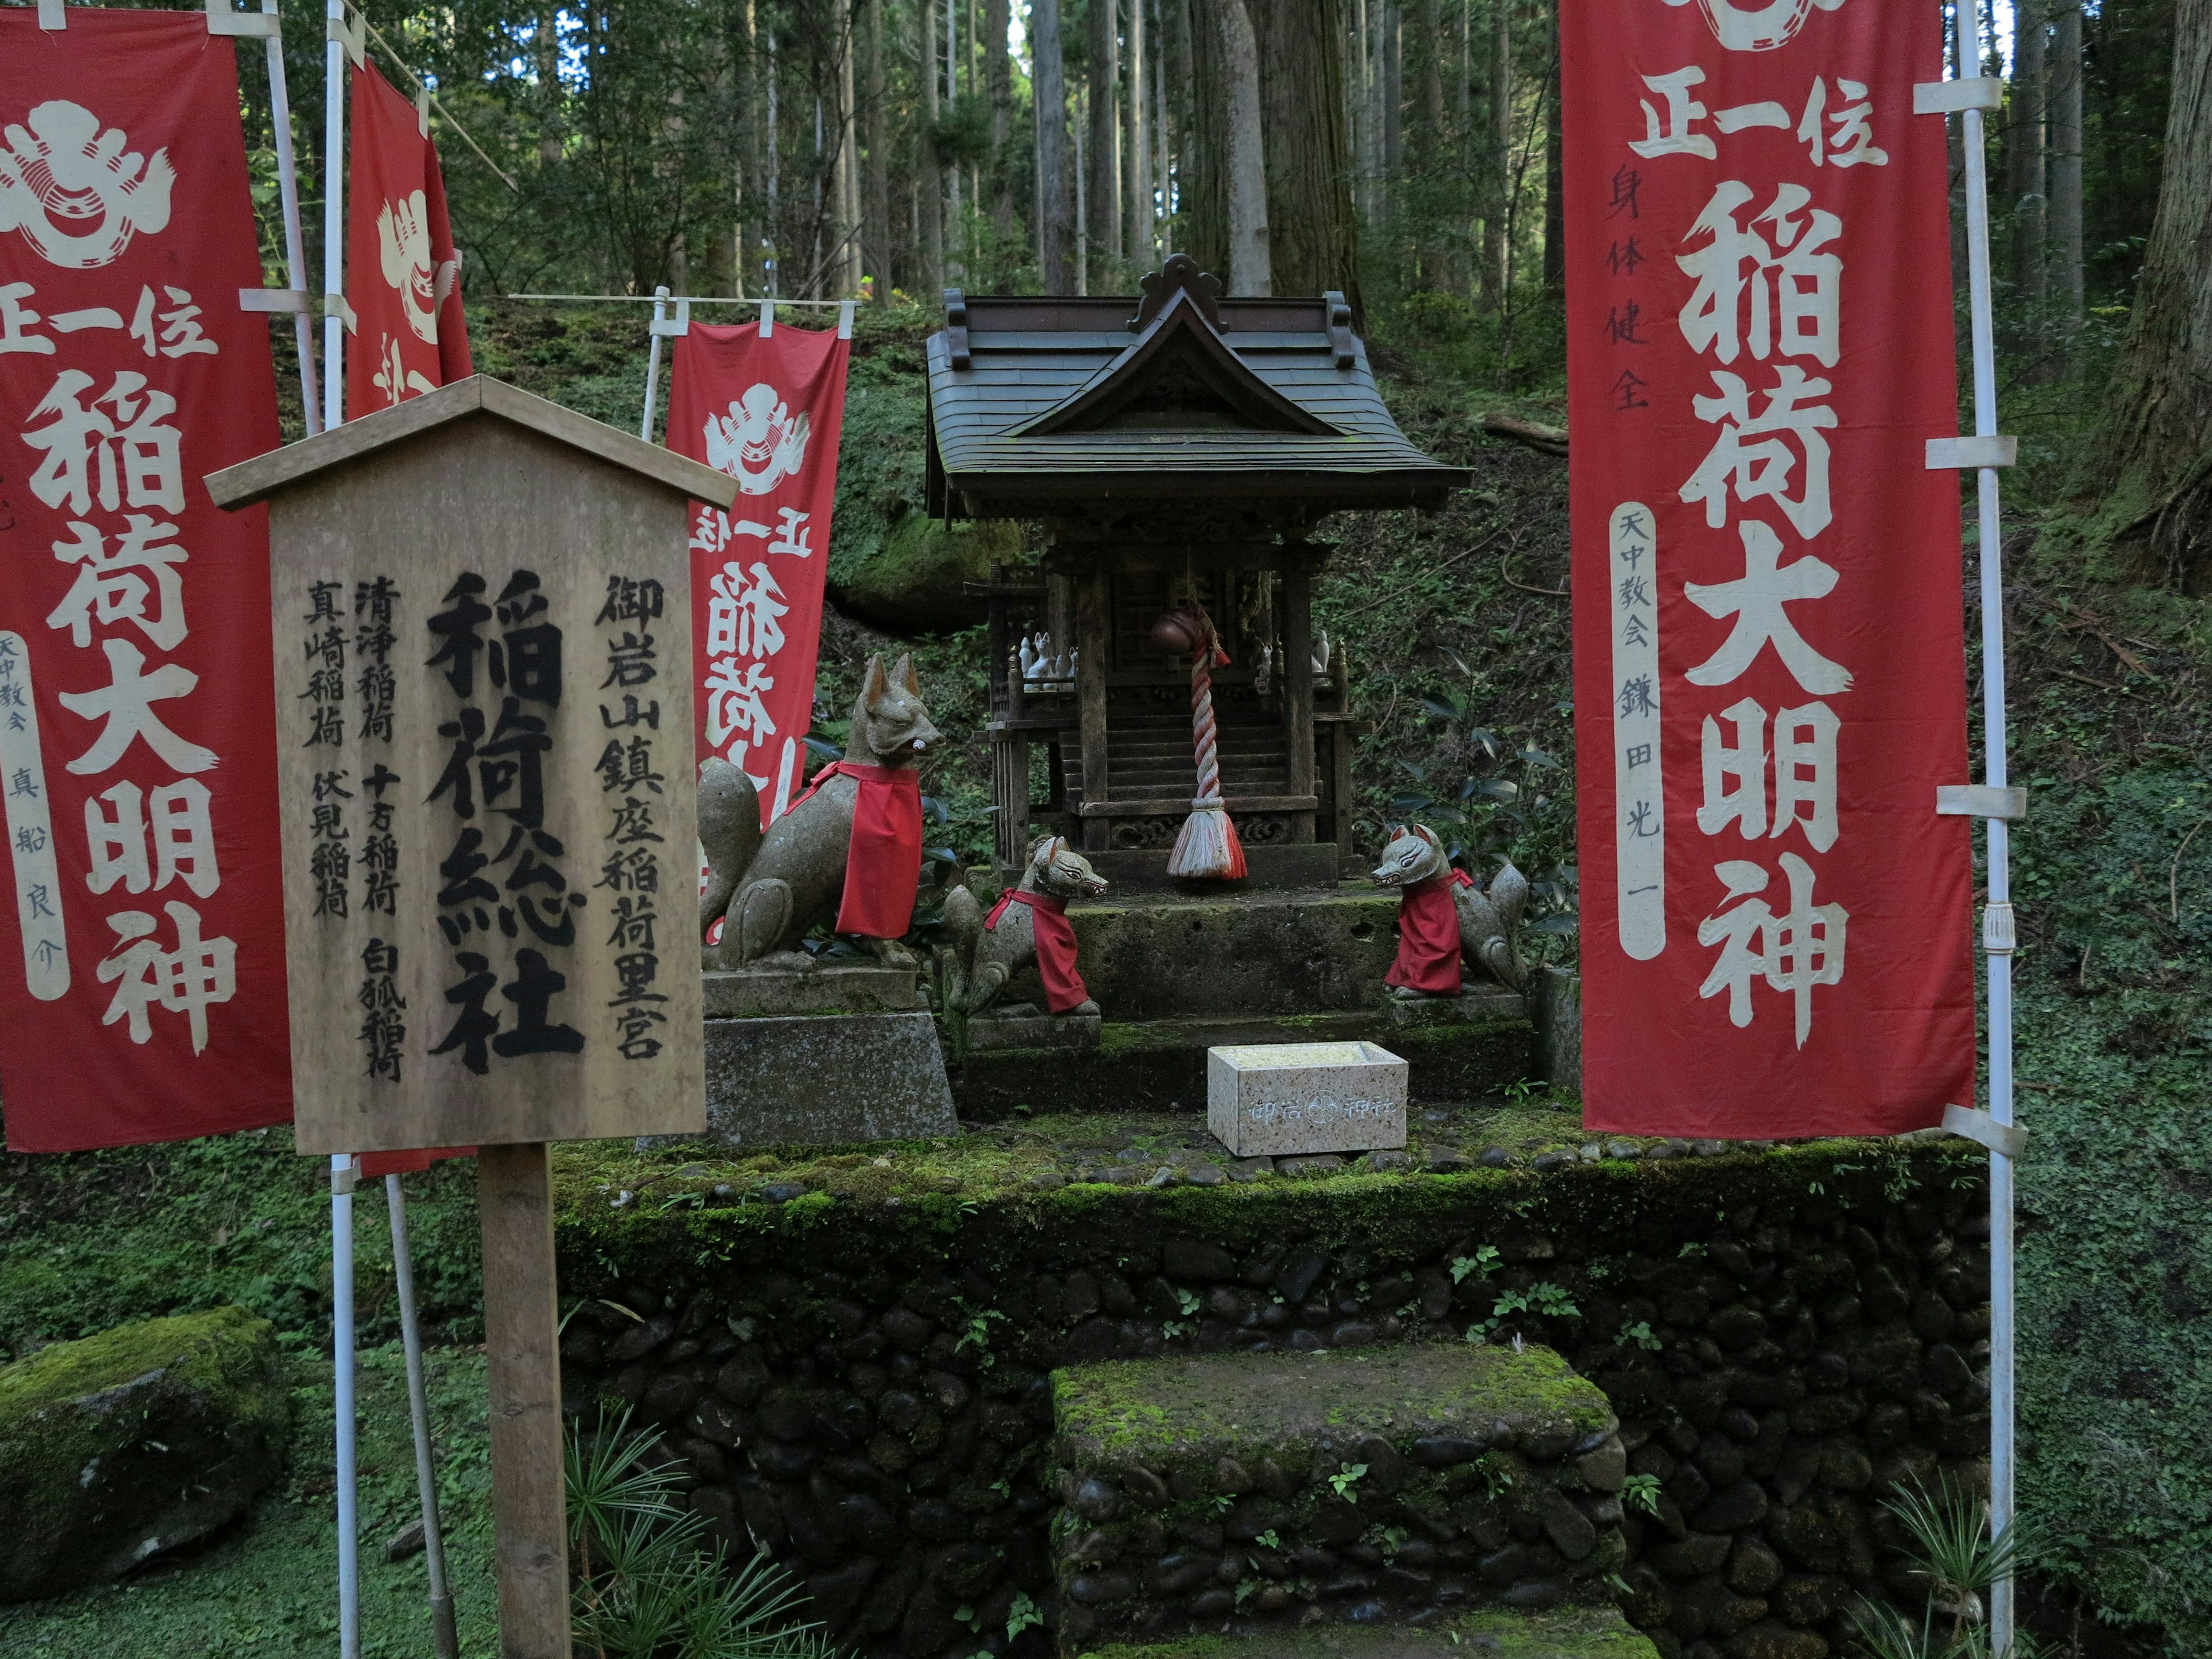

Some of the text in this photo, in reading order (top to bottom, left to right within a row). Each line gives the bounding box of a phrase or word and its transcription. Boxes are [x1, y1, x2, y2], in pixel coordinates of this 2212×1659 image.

[1627, 65, 1888, 167] 正一位
[0, 282, 219, 358] 正一位
[1604, 164, 1649, 411] 身体健全
[20, 369, 237, 1058] 稲荷大明神
[297, 580, 354, 919] 真崎稲荷 伏見稲荷
[354, 577, 401, 743] 清浄稲荷
[1615, 511, 1660, 896] 天中教会 鎌田光一
[1675, 180, 1855, 1051] 稲荷大明神
[9, 767, 63, 975] 真船良介
[423, 569, 587, 1075] 稲荷総社
[592, 575, 667, 1061] 御岩山鎮座稲荷里宮
[357, 937, 407, 1083] 白狐稲荷
